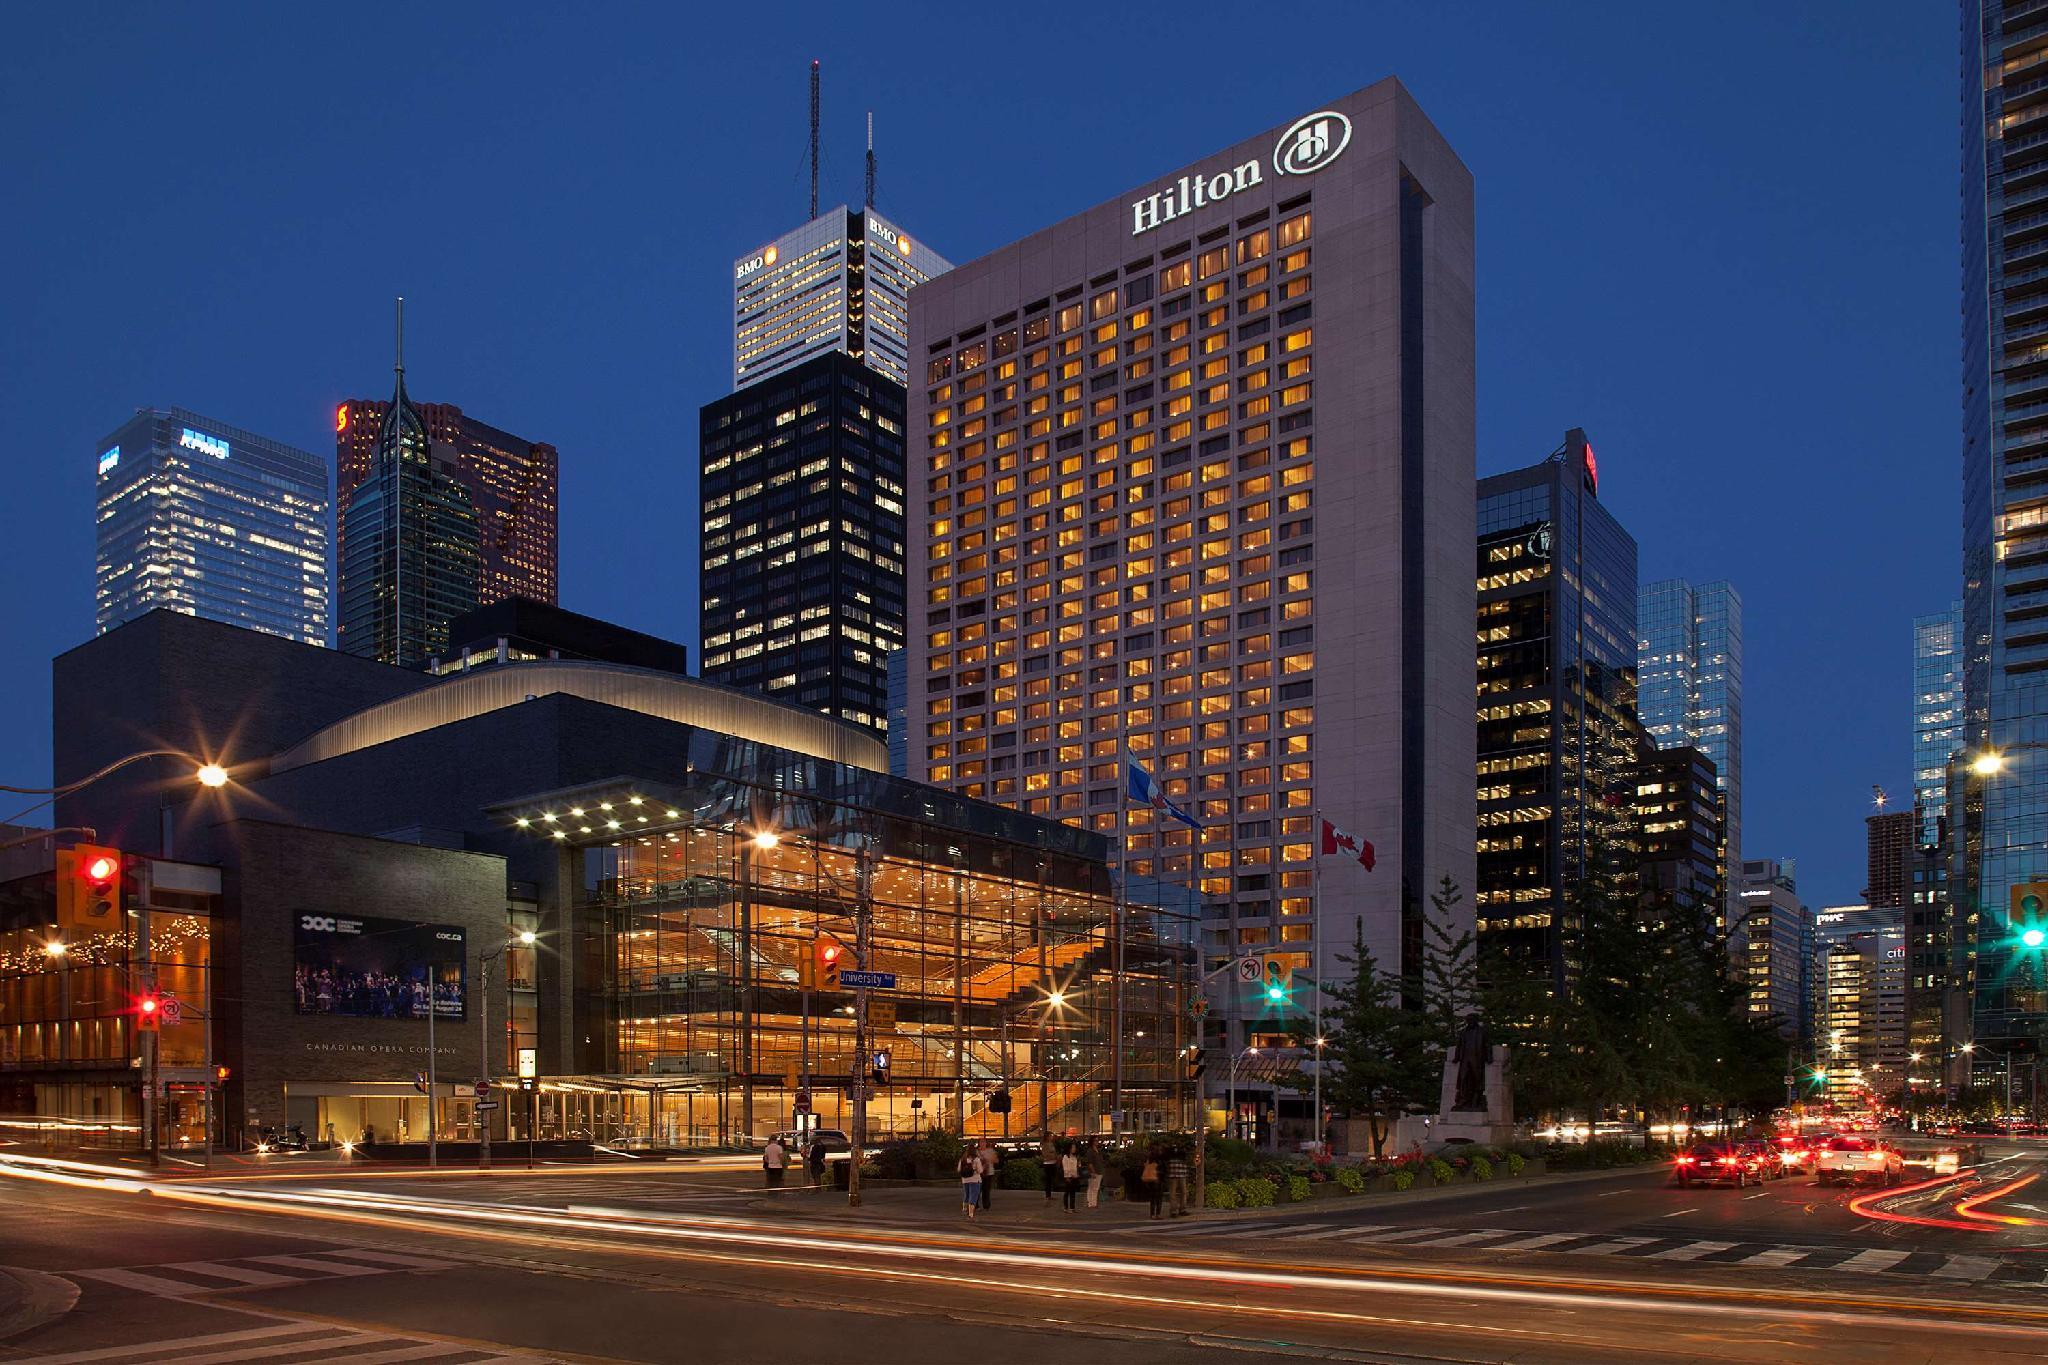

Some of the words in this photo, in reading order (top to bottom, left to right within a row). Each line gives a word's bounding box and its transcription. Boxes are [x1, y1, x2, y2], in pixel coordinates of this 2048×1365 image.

[1132, 159, 1263, 236] Hilton
[869, 218, 897, 245] BMO
[736, 256, 763, 279] BMO
[180, 433, 228, 460] KPMG
[1816, 913, 1844, 926] pwc
[436, 932, 462, 941] coc.ca
[840, 971, 882, 986] University
[306, 1043, 365, 1051] CANADIAN
[370, 1045, 403, 1053] OPERA
[409, 1046, 457, 1054] COMPANY
